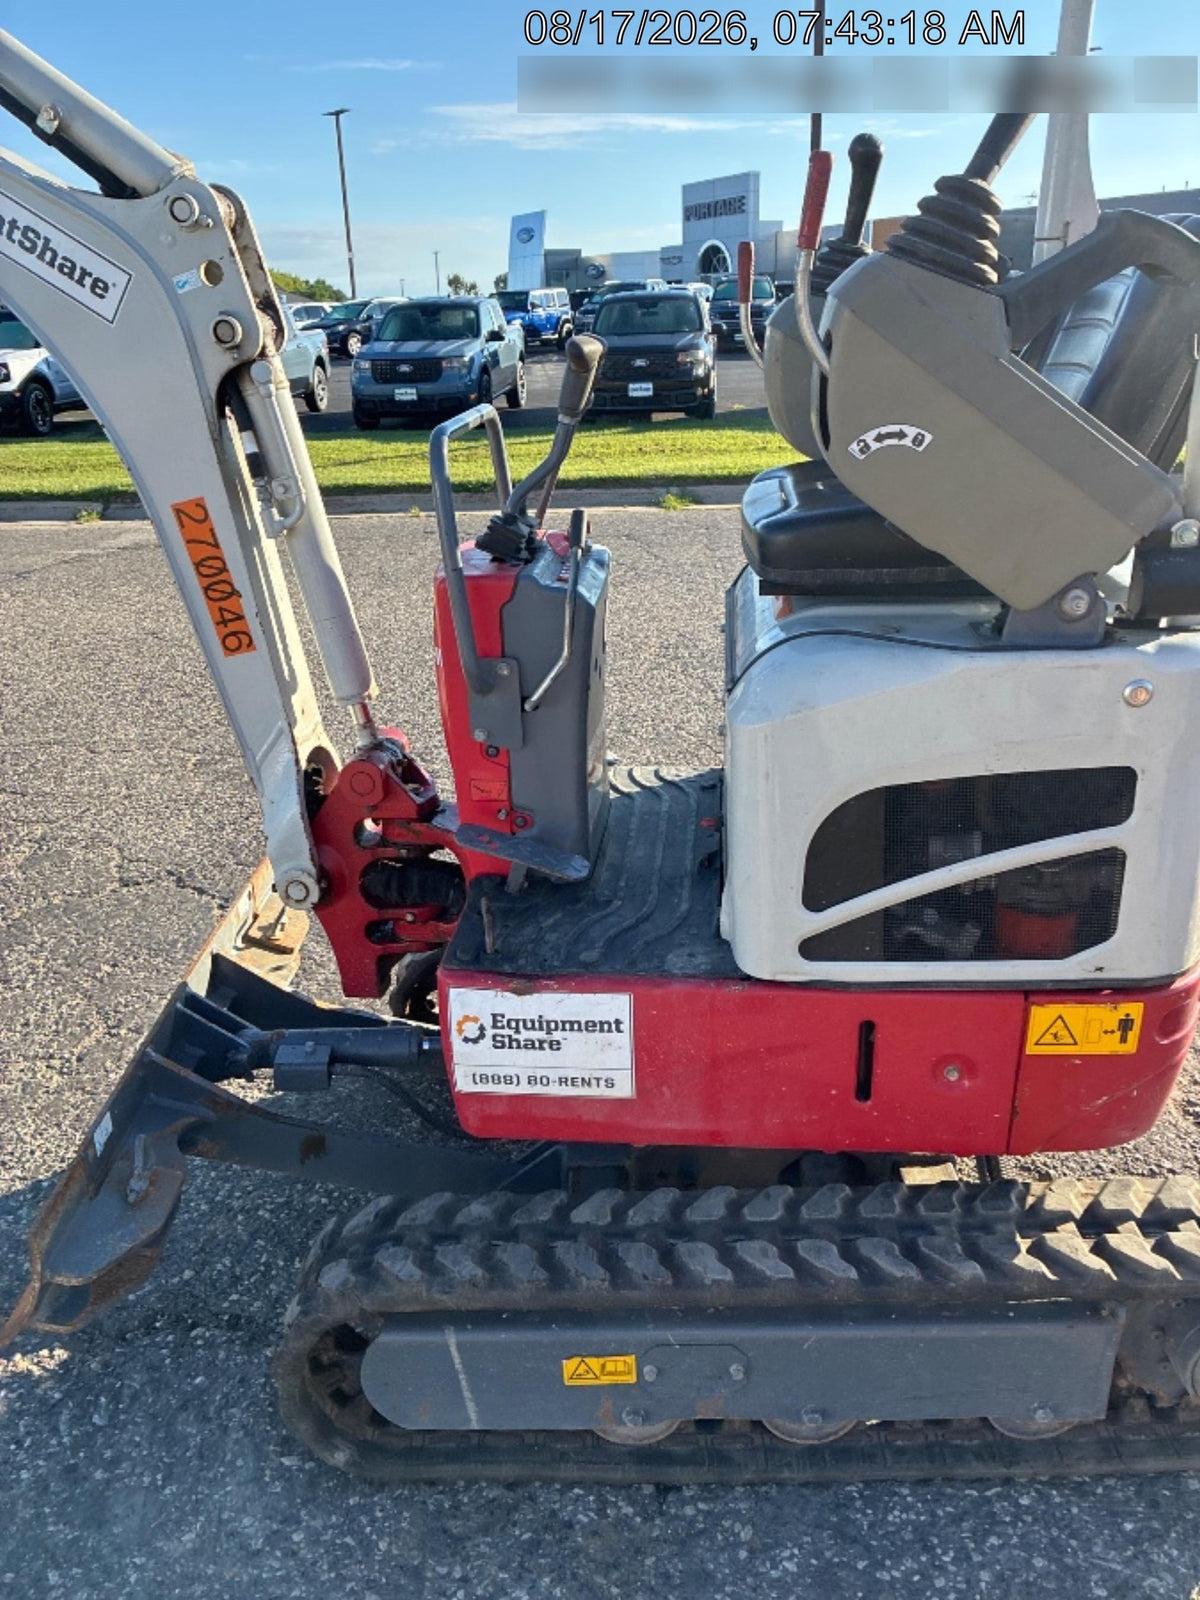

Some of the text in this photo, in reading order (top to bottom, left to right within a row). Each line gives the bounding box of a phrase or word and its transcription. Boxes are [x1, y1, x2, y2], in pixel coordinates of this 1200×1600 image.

[174, 503, 253, 653] 270046
[490, 1012, 624, 1035] Equipment
[491, 1034, 562, 1052] Share
[472, 1073, 615, 1089] (888) 80-RENTS
